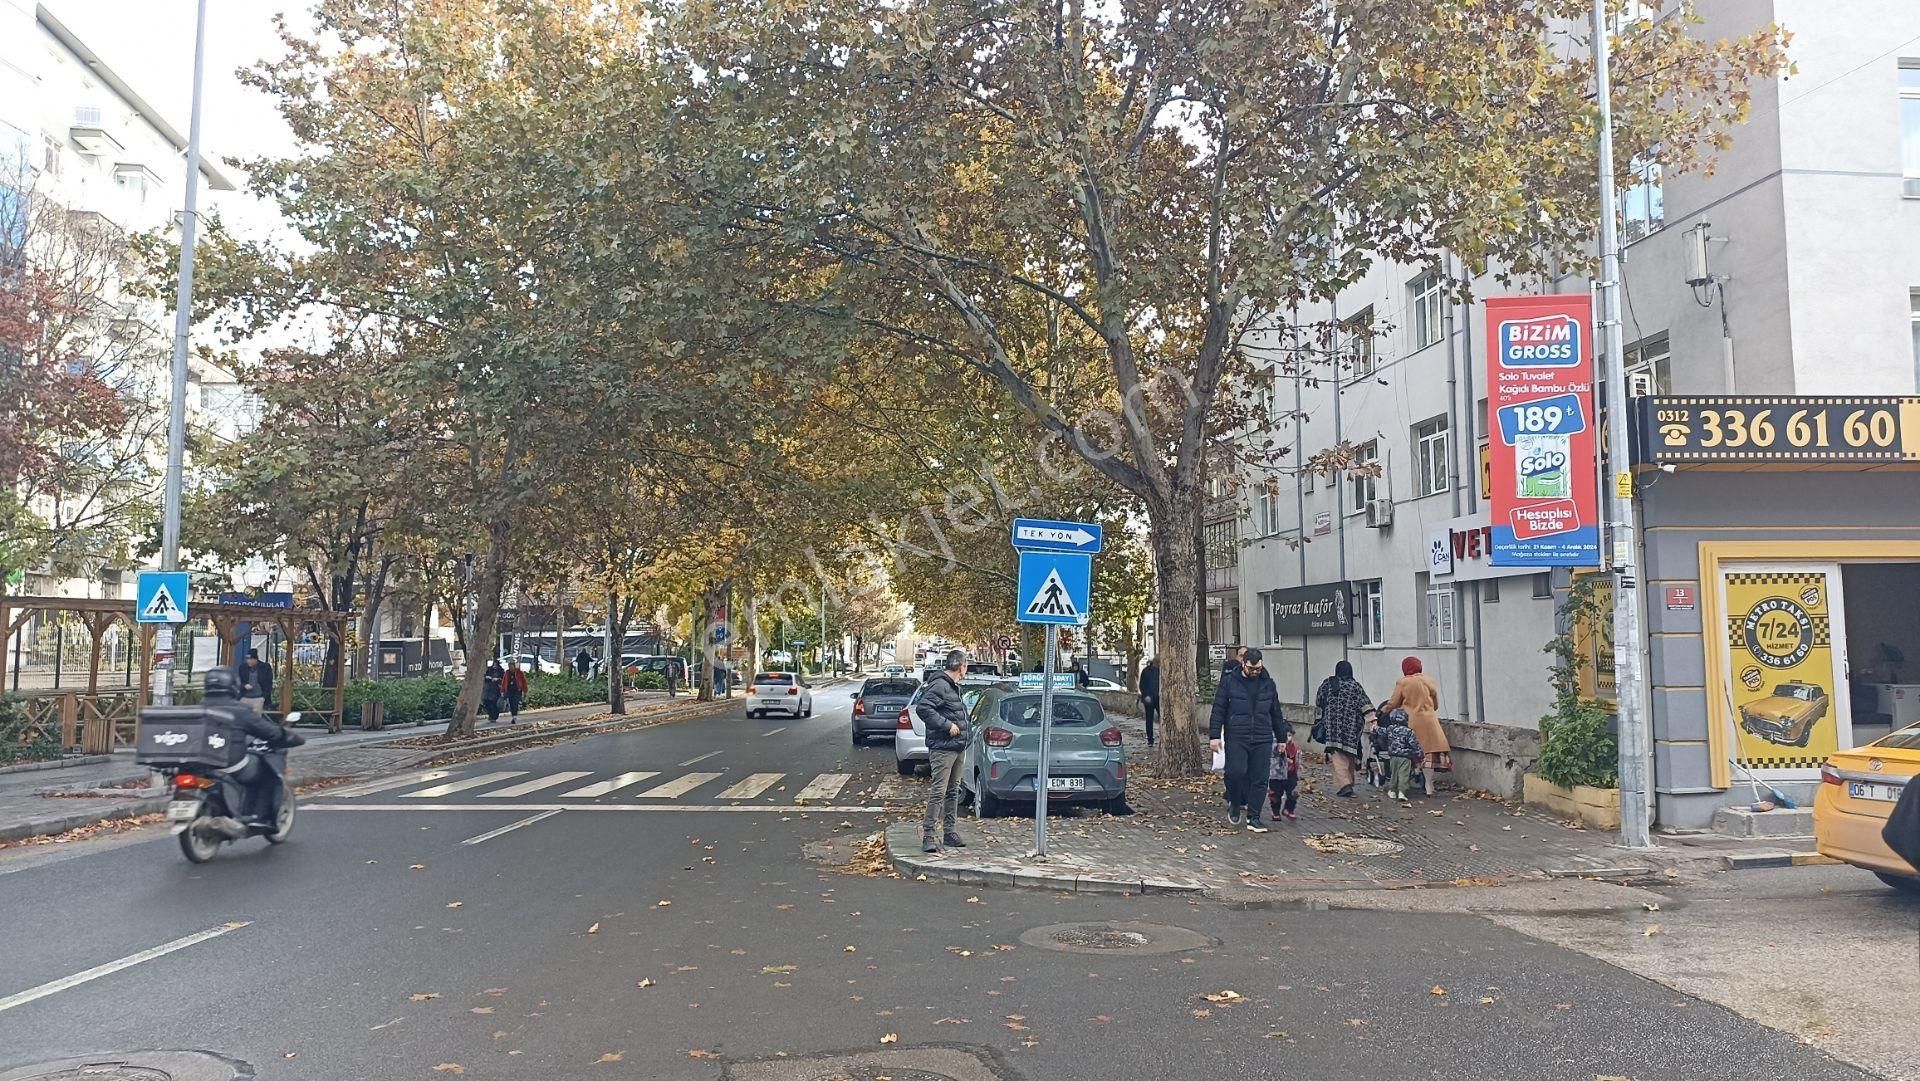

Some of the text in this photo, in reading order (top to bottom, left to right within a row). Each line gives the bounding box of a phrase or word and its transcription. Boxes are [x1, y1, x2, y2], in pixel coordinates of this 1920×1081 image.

[1509, 344, 1571, 359] GROSS
[1499, 371, 1555, 381] Solo Tuvalet
[1499, 381, 1590, 395] Kağıdı Bambu Özlü
[1513, 406, 1563, 432] 189
[1657, 410, 1689, 422] 0312
[1700, 409, 1896, 448] 336 61 60
[1517, 508, 1572, 521] Hesaplısı
[1530, 519, 1564, 531] Bizde
[1023, 529, 1043, 537] TEK
[1452, 526, 1491, 560] VET
[1675, 589, 1685, 597] 13
[1275, 598, 1333, 619] Poyraz Kuaför
[1746, 600, 1777, 630] METRO
[1759, 618, 1799, 640] 7/24
[1760, 644, 1809, 665] 336 61 60
[153, 731, 188, 746] vigo
[1854, 784, 1865, 796] 06
[1870, 785, 1875, 797] T
